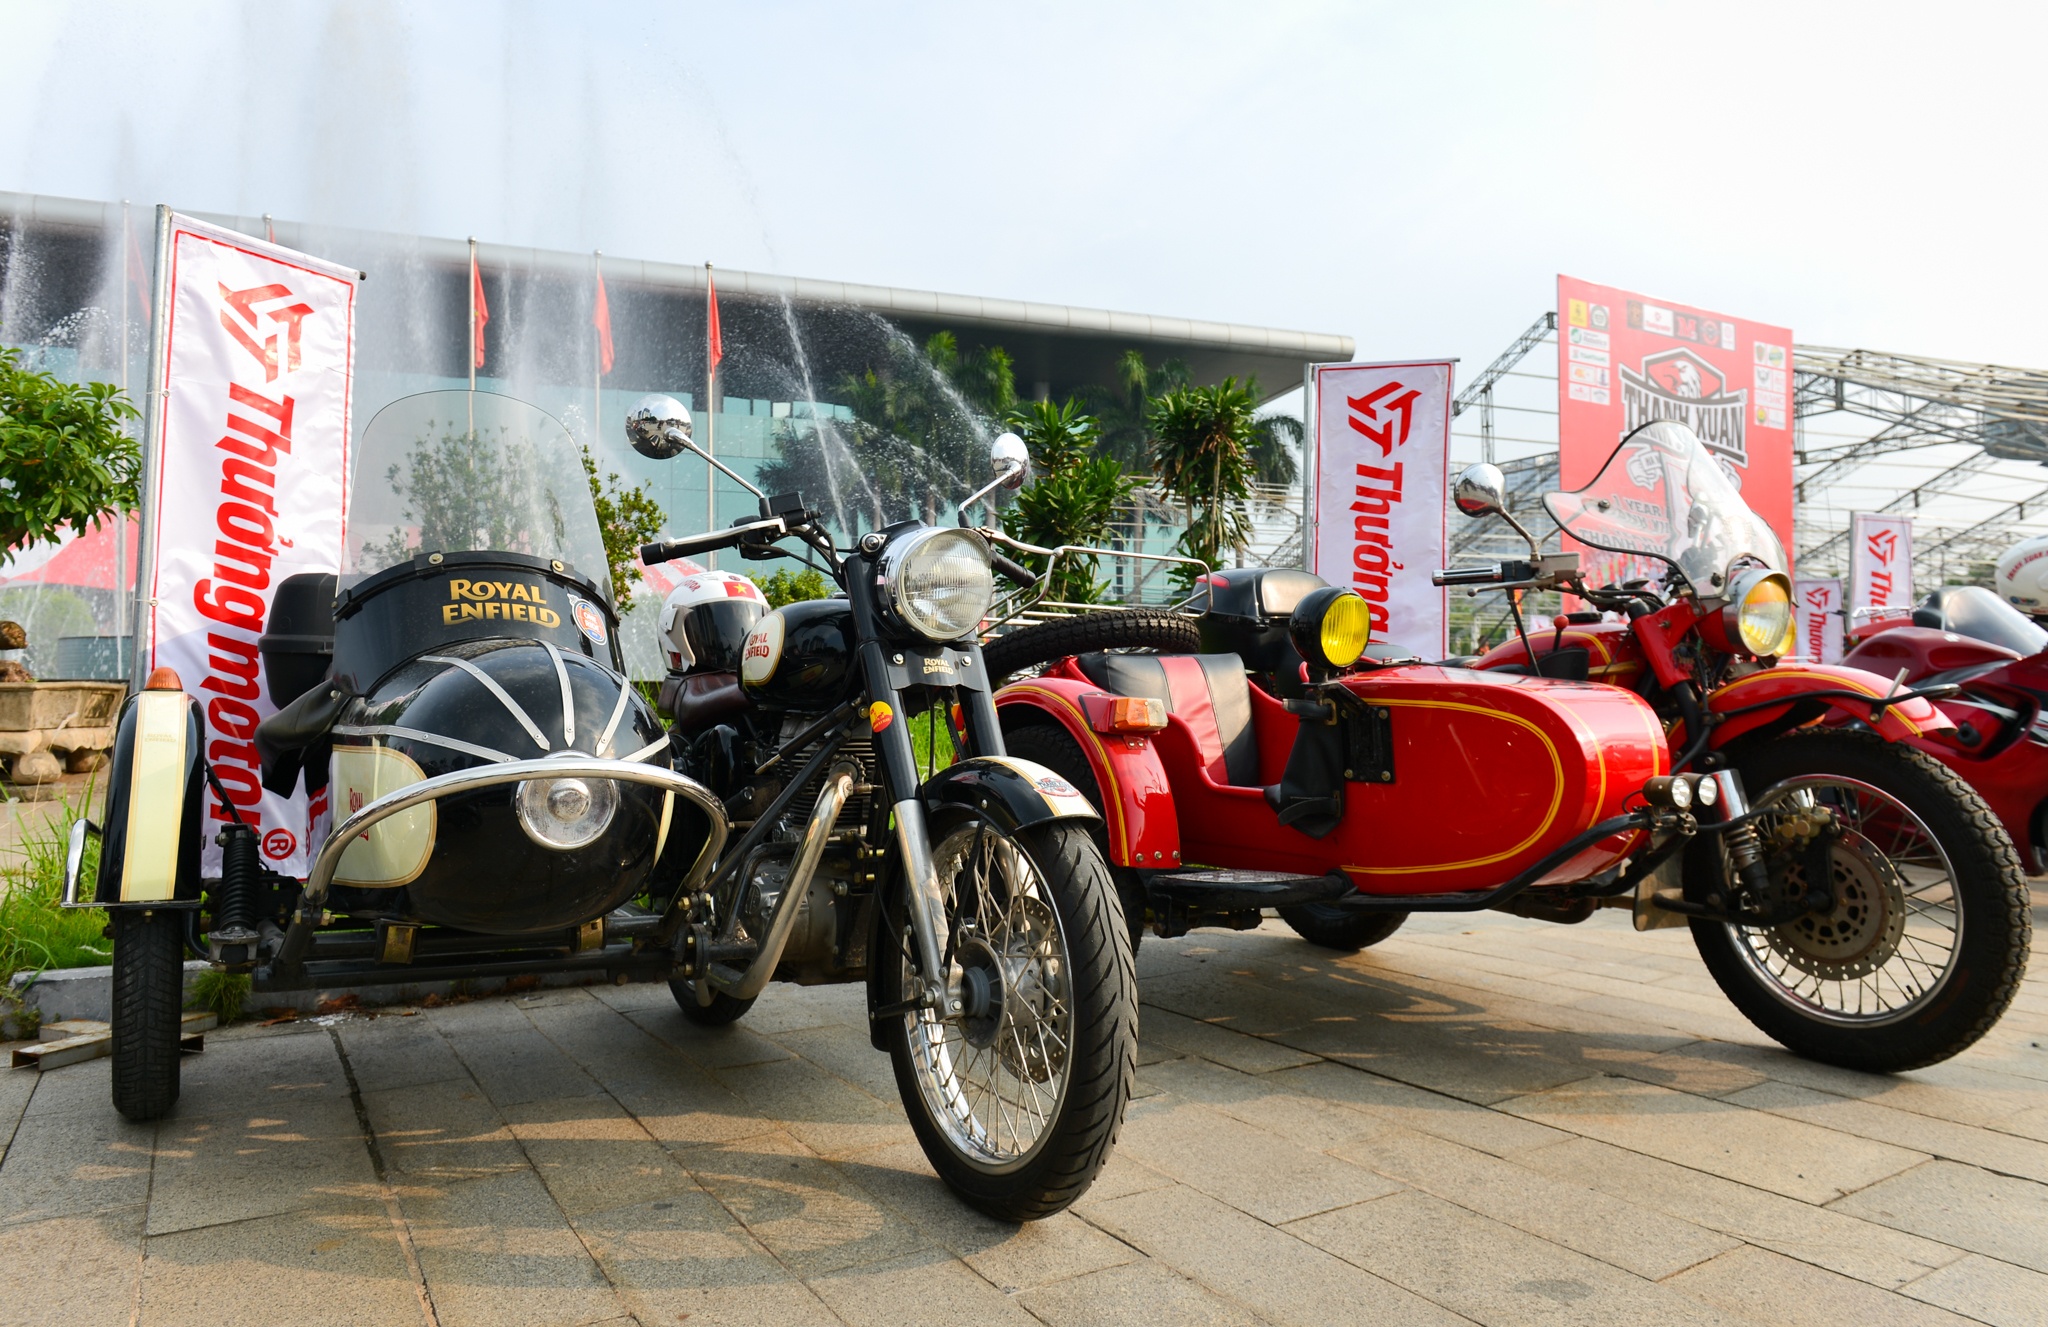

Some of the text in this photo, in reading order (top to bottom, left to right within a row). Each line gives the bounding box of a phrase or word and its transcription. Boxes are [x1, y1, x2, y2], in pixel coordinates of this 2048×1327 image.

[1696, 404, 1744, 453] XUAN
[193, 381, 295, 634] Thưởng
[1624, 498, 1663, 517] YEAR
[450, 579, 548, 604] ROYAL
[442, 601, 562, 629] ENFIELD
[922, 666, 954, 675] ENFIELD
[923, 657, 950, 667] ROYAL
